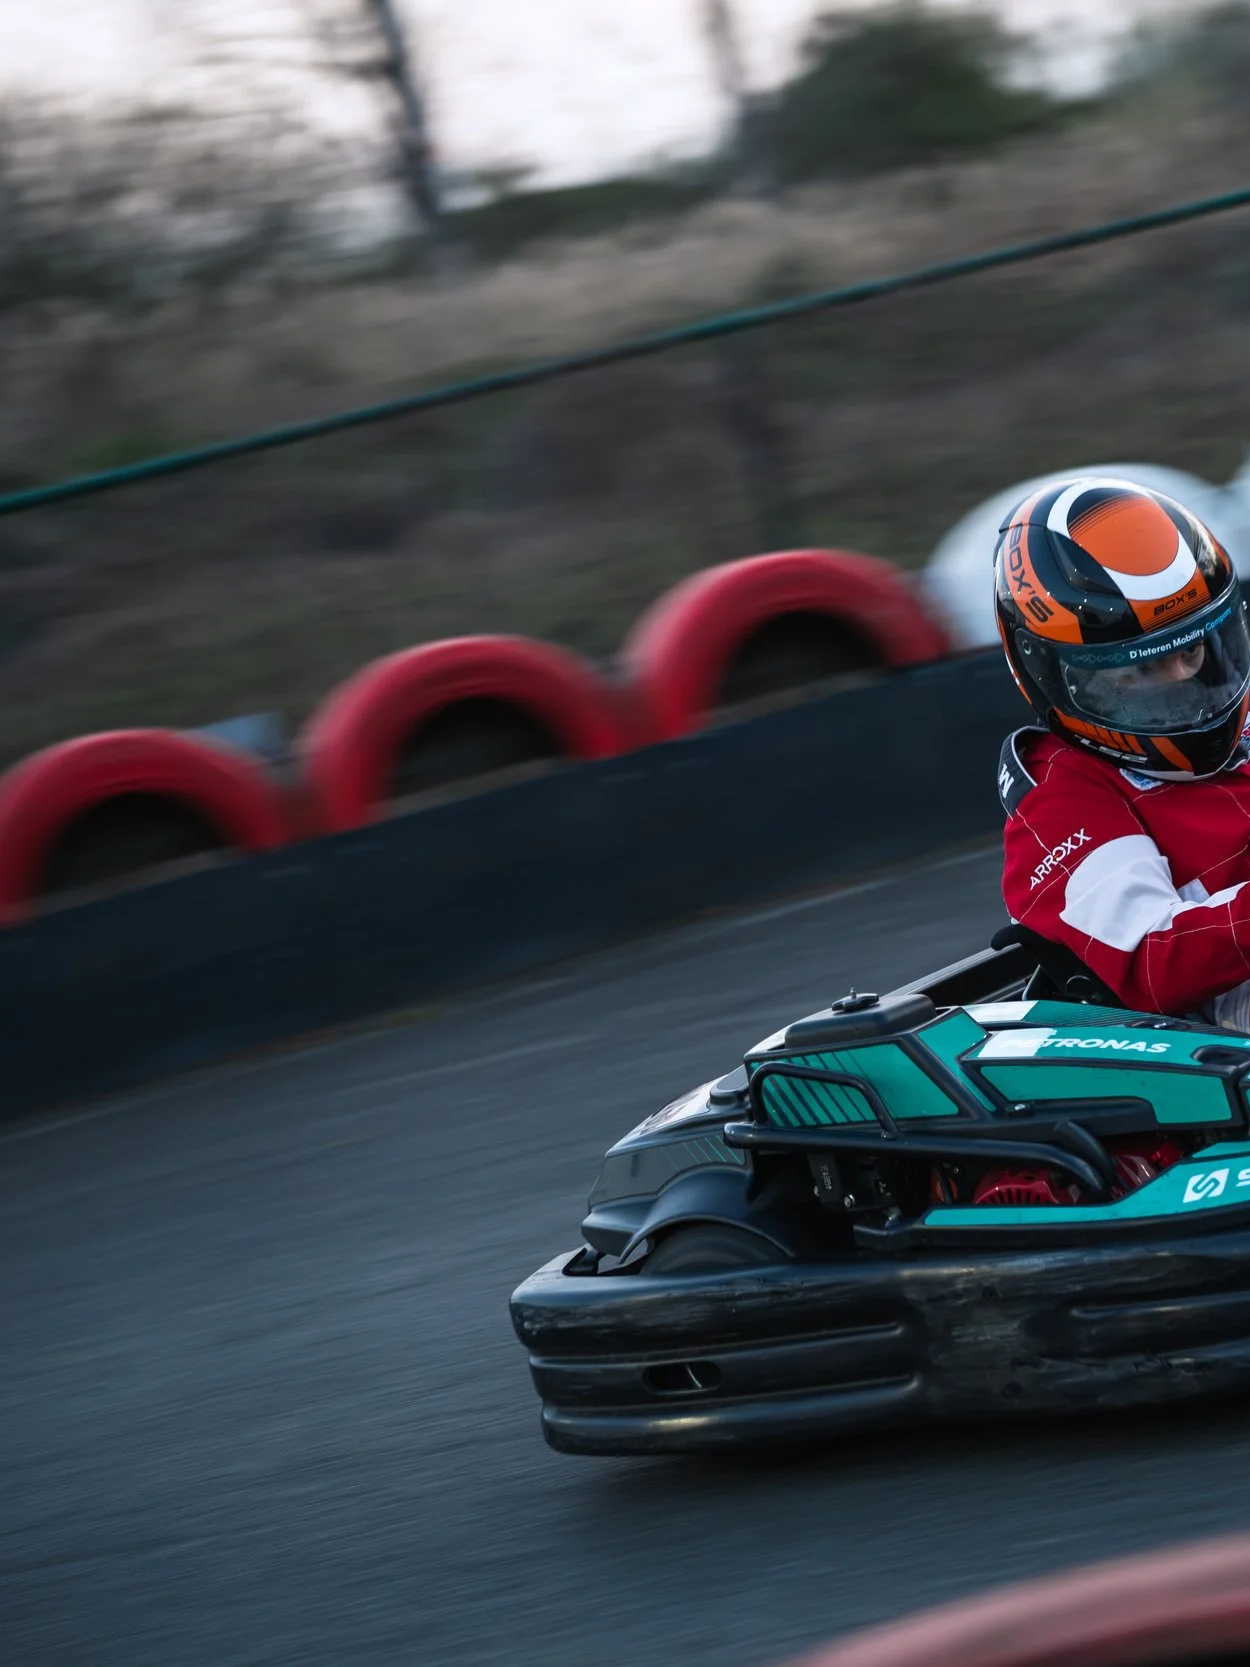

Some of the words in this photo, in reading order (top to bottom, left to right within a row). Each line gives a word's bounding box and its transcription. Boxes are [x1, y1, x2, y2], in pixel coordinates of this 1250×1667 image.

[1008, 522, 1055, 623] BOX'S
[1153, 588, 1198, 616] BOX'S
[1172, 628, 1205, 648] Mobility
[1029, 828, 1092, 891] ARROXX
